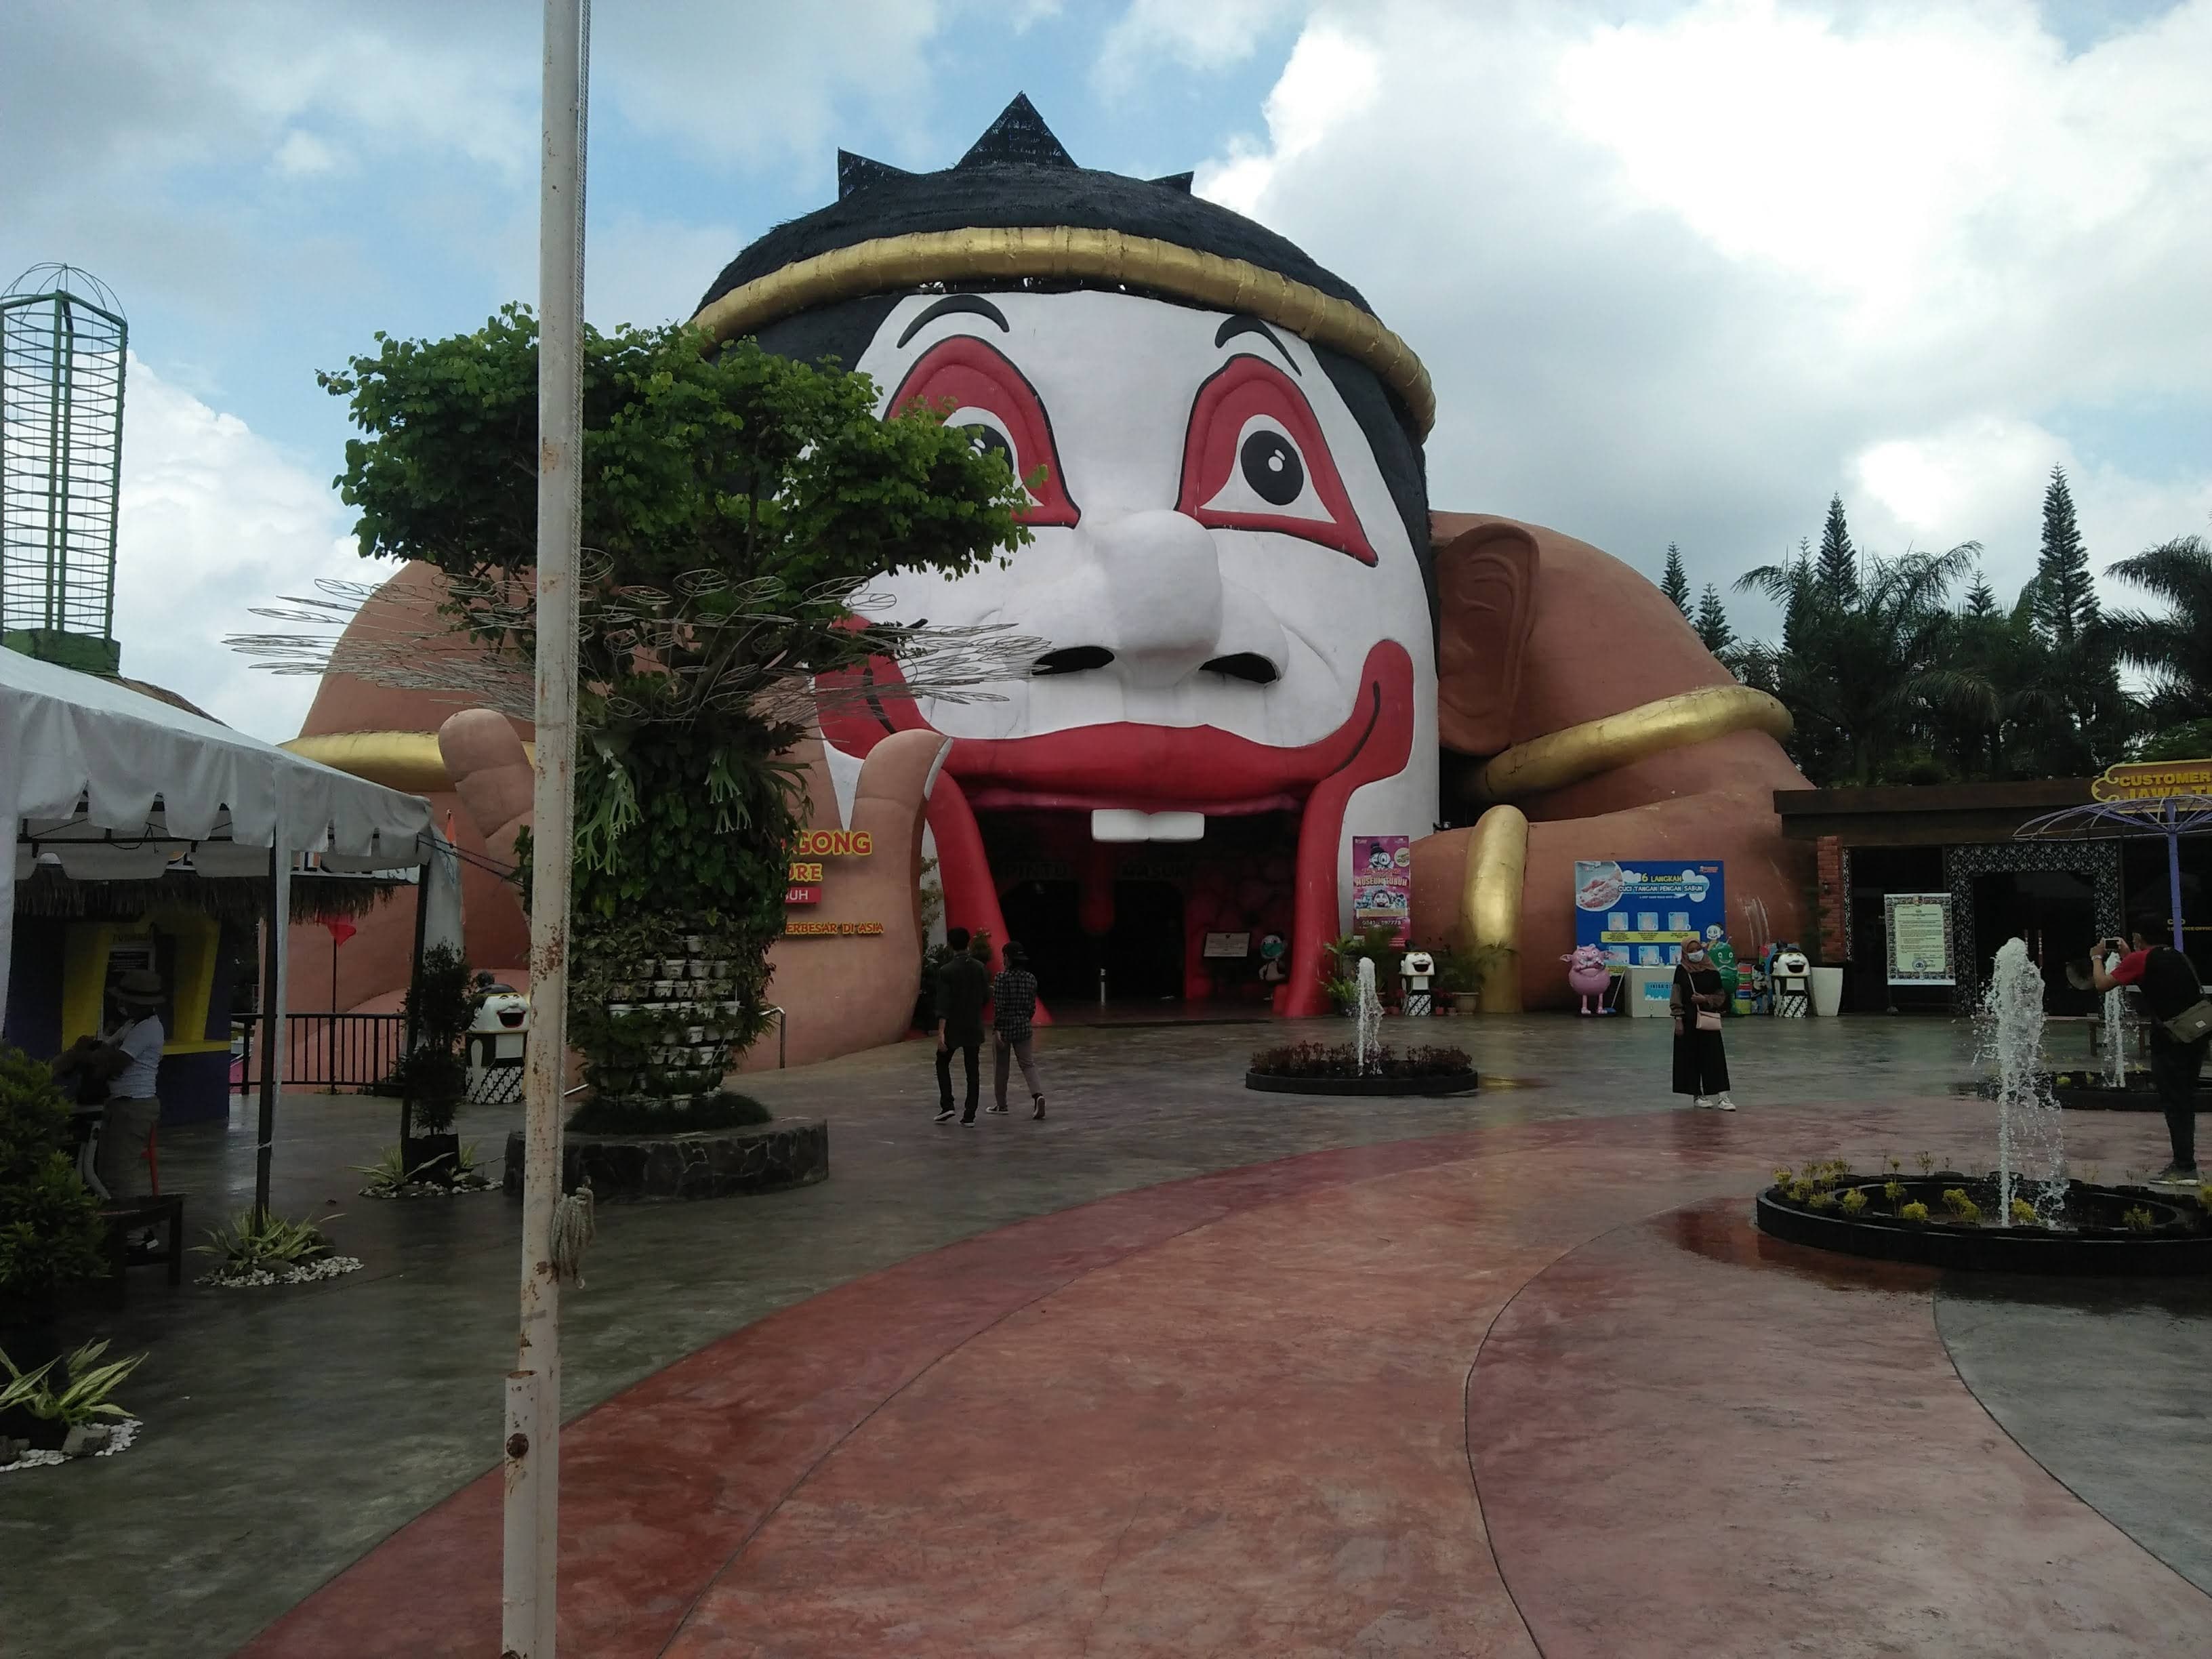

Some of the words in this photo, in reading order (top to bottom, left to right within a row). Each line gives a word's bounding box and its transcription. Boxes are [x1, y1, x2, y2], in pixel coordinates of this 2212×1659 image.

[2119, 771, 2211, 787] CUSTOMER
[781, 830, 873, 856] GONG
[785, 922, 838, 935] ERBESAR
[842, 922, 856, 935] DI
[858, 922, 884, 934] ASIA
